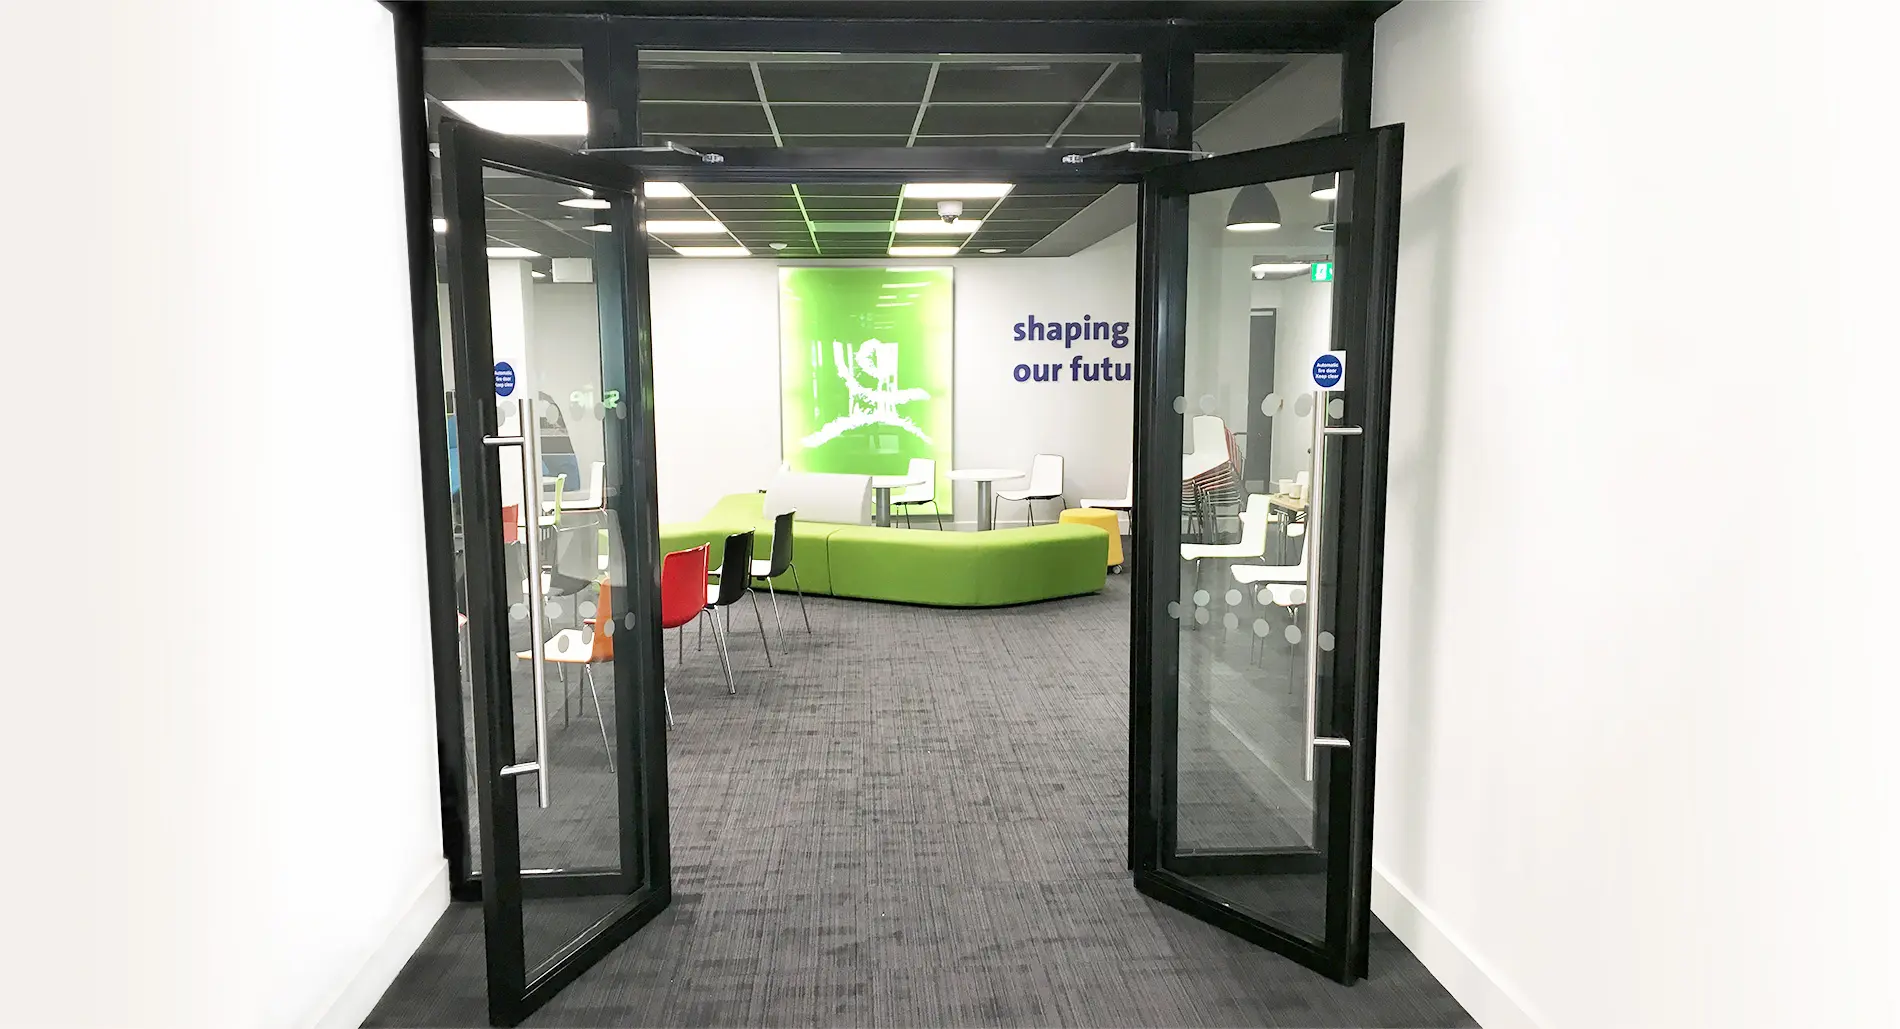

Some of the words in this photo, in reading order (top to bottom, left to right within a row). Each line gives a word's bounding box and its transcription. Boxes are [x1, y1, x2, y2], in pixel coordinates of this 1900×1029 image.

[1013, 314, 1130, 348] shaping
[1013, 363, 1063, 382] our
[1069, 355, 1132, 381] futu
